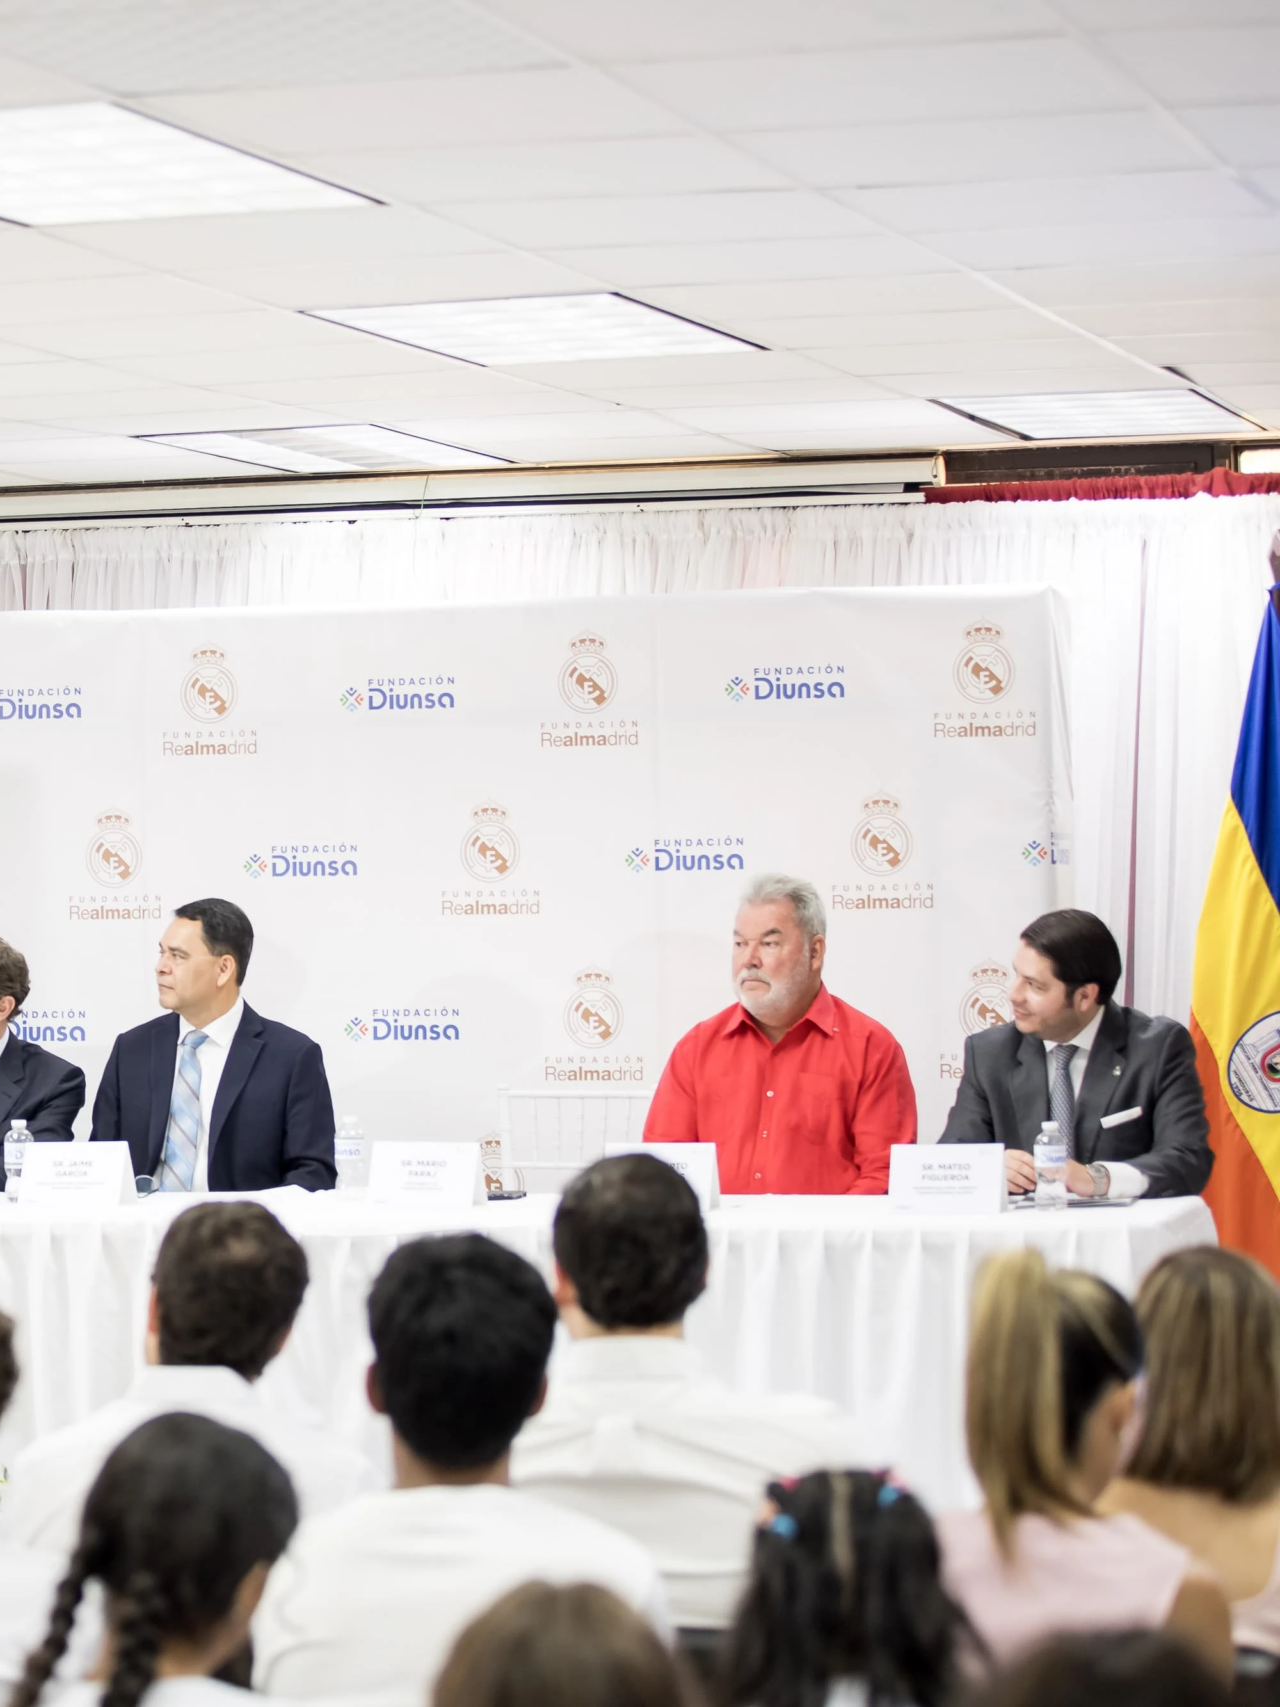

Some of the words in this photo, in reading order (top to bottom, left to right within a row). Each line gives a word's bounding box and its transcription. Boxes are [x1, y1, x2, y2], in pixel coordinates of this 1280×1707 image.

[753, 664, 845, 676] FUNDACIÓN
[367, 675, 455, 687] FUNDACIÓN
[754, 676, 845, 701] Diunsa
[368, 687, 455, 711] Diunsa
[933, 709, 1036, 721] FUNDACIÓN
[540, 720, 638, 730] FUNDACIÓN
[934, 720, 1036, 739] Realmadrid
[163, 729, 258, 740] FUNDACIÓN
[540, 730, 639, 748] Realmadrid
[163, 739, 258, 757] Realmadrid
[271, 843, 358, 854] FUNDACIÓN
[654, 837, 744, 848] FUNDACIÓN
[271, 854, 358, 878] Diunsa
[654, 848, 744, 872] Diunsa
[441, 888, 540, 898] FUNDACIÓN
[832, 882, 934, 893] FUNDACIÓN
[69, 894, 162, 904] FUNDACIÓN
[832, 893, 934, 910] Realmadrid
[69, 904, 162, 921] Realmadrid
[441, 899, 540, 916] Realmadrid
[21, 1008, 86, 1019] NDACIÓN
[372, 1006, 460, 1018] FUNDACIÓN
[372, 1018, 460, 1042] Diunsa
[544, 1055, 644, 1064] FUNDACIÓN
[545, 1065, 643, 1082] Realmadrid
[938, 1163, 971, 1171] MATEO
